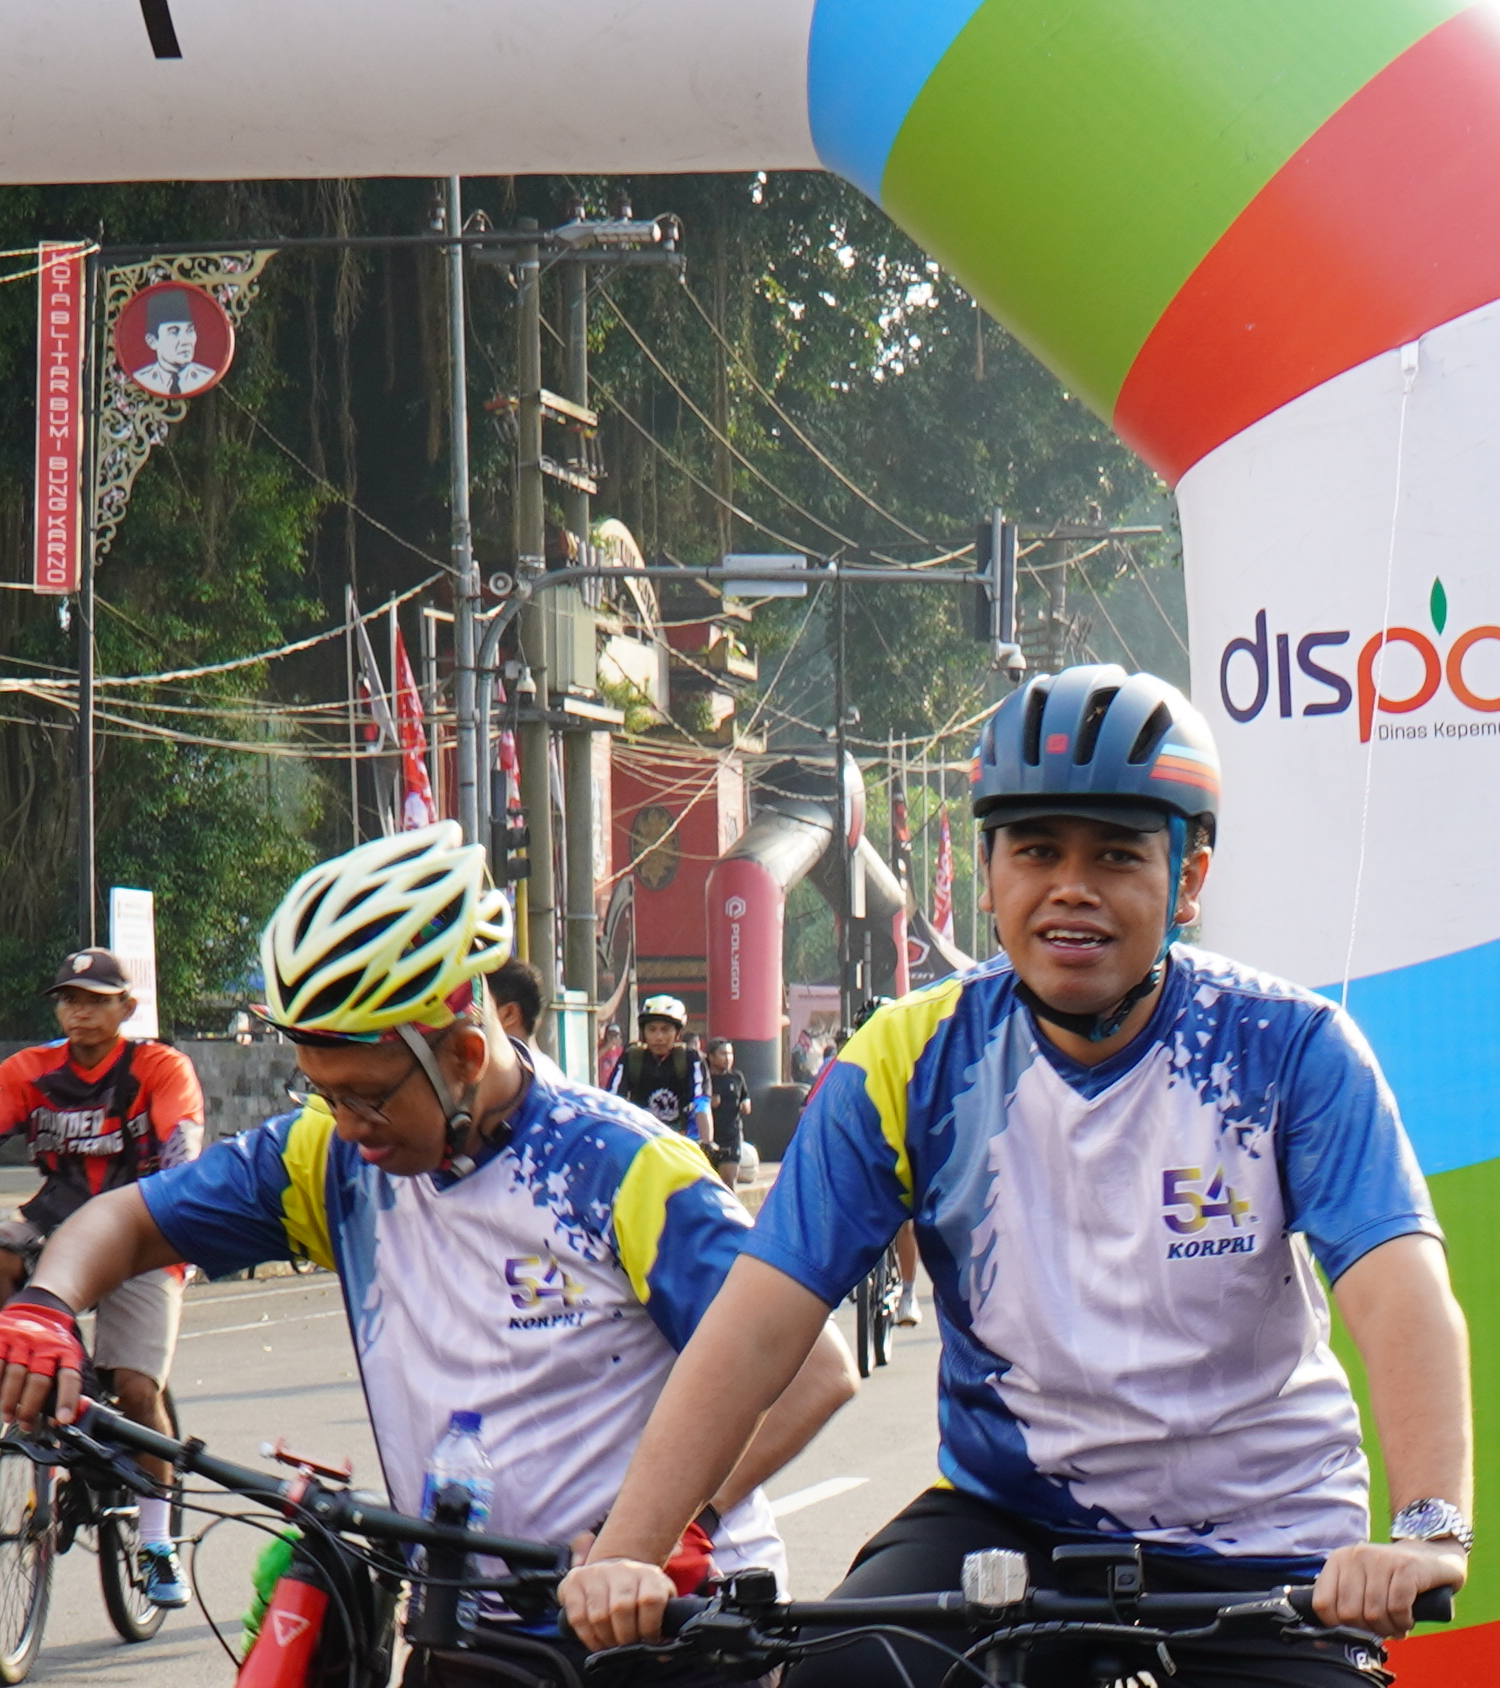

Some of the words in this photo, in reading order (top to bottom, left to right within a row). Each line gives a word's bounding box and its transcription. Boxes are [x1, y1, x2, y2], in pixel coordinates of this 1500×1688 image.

[51, 252, 71, 306] KOTA
[50, 311, 70, 394] BLITAR
[49, 397, 69, 452] BUMI
[48, 456, 68, 512] BUNG
[46, 515, 67, 584] KARNO
[1377, 721, 1429, 742] Dinas
[730, 922, 741, 1000] POLYGON
[1162, 1166, 1250, 1235] 54
[1166, 1234, 1257, 1260] KORPRI
[505, 1256, 586, 1310] 54
